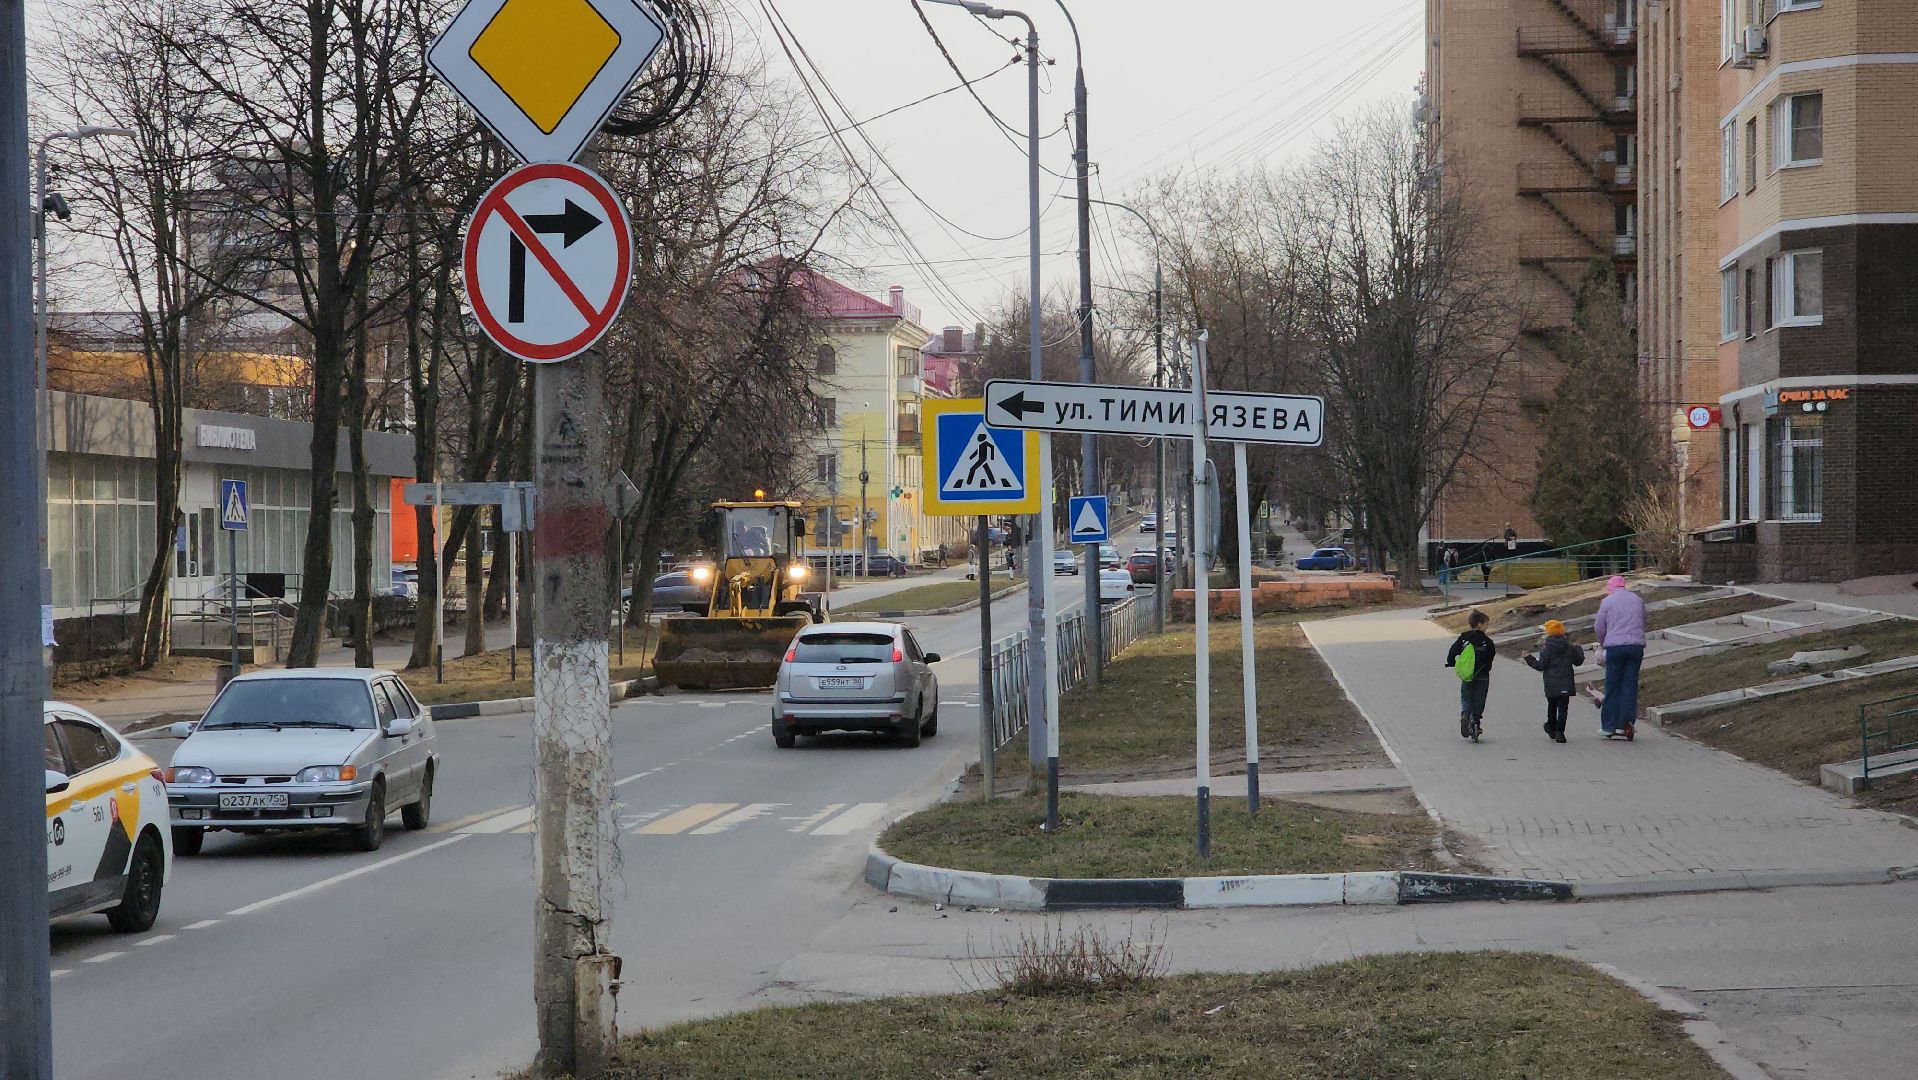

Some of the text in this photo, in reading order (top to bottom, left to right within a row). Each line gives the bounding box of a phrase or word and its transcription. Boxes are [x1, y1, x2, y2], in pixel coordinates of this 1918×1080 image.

[1054, 398, 1312, 432] ул. ТИМИЯЗЕВА
[199, 424, 257, 450] БИБЛИОТЕКА
